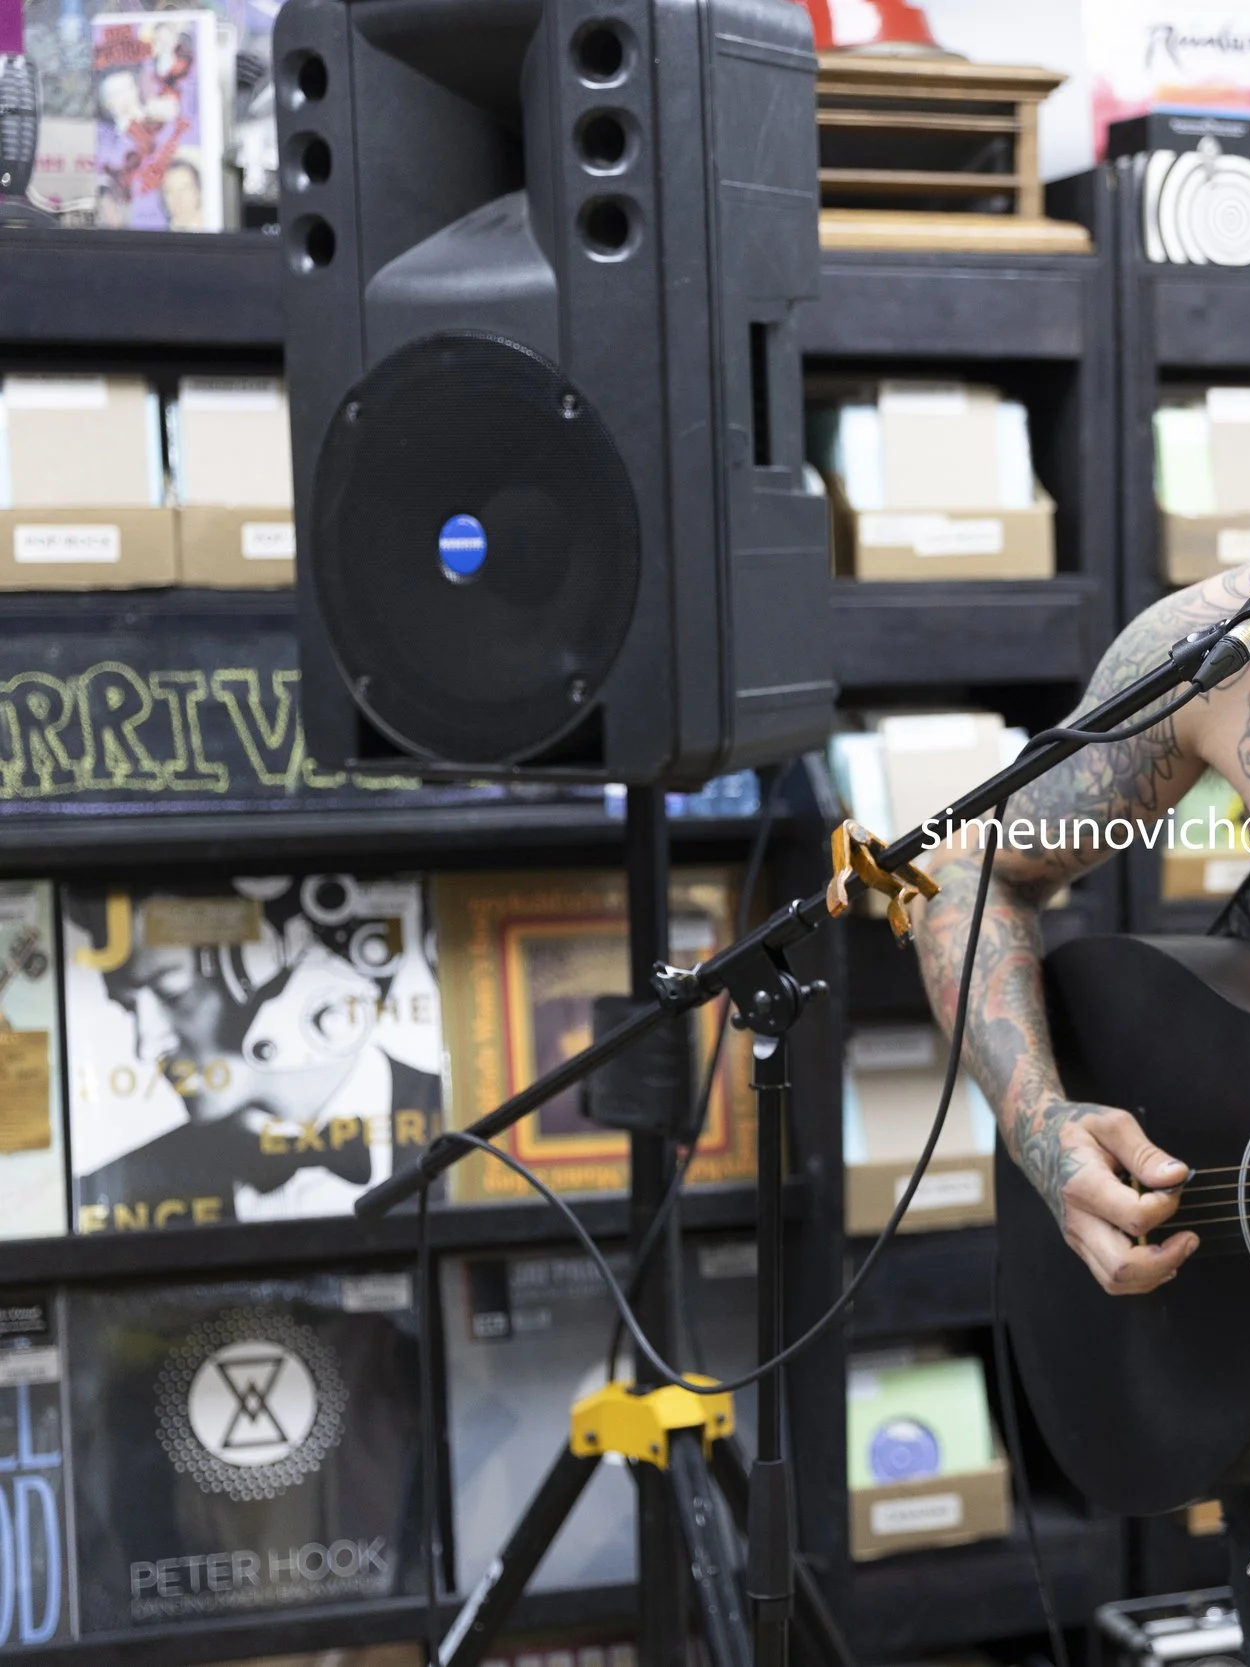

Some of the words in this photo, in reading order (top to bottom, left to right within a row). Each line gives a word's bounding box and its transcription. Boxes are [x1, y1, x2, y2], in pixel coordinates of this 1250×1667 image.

[0, 660, 424, 798] RRIV
[77, 1056, 232, 1102] 0/20
[129, 1550, 263, 1600] PETER
[268, 1534, 388, 1582] HOOK
